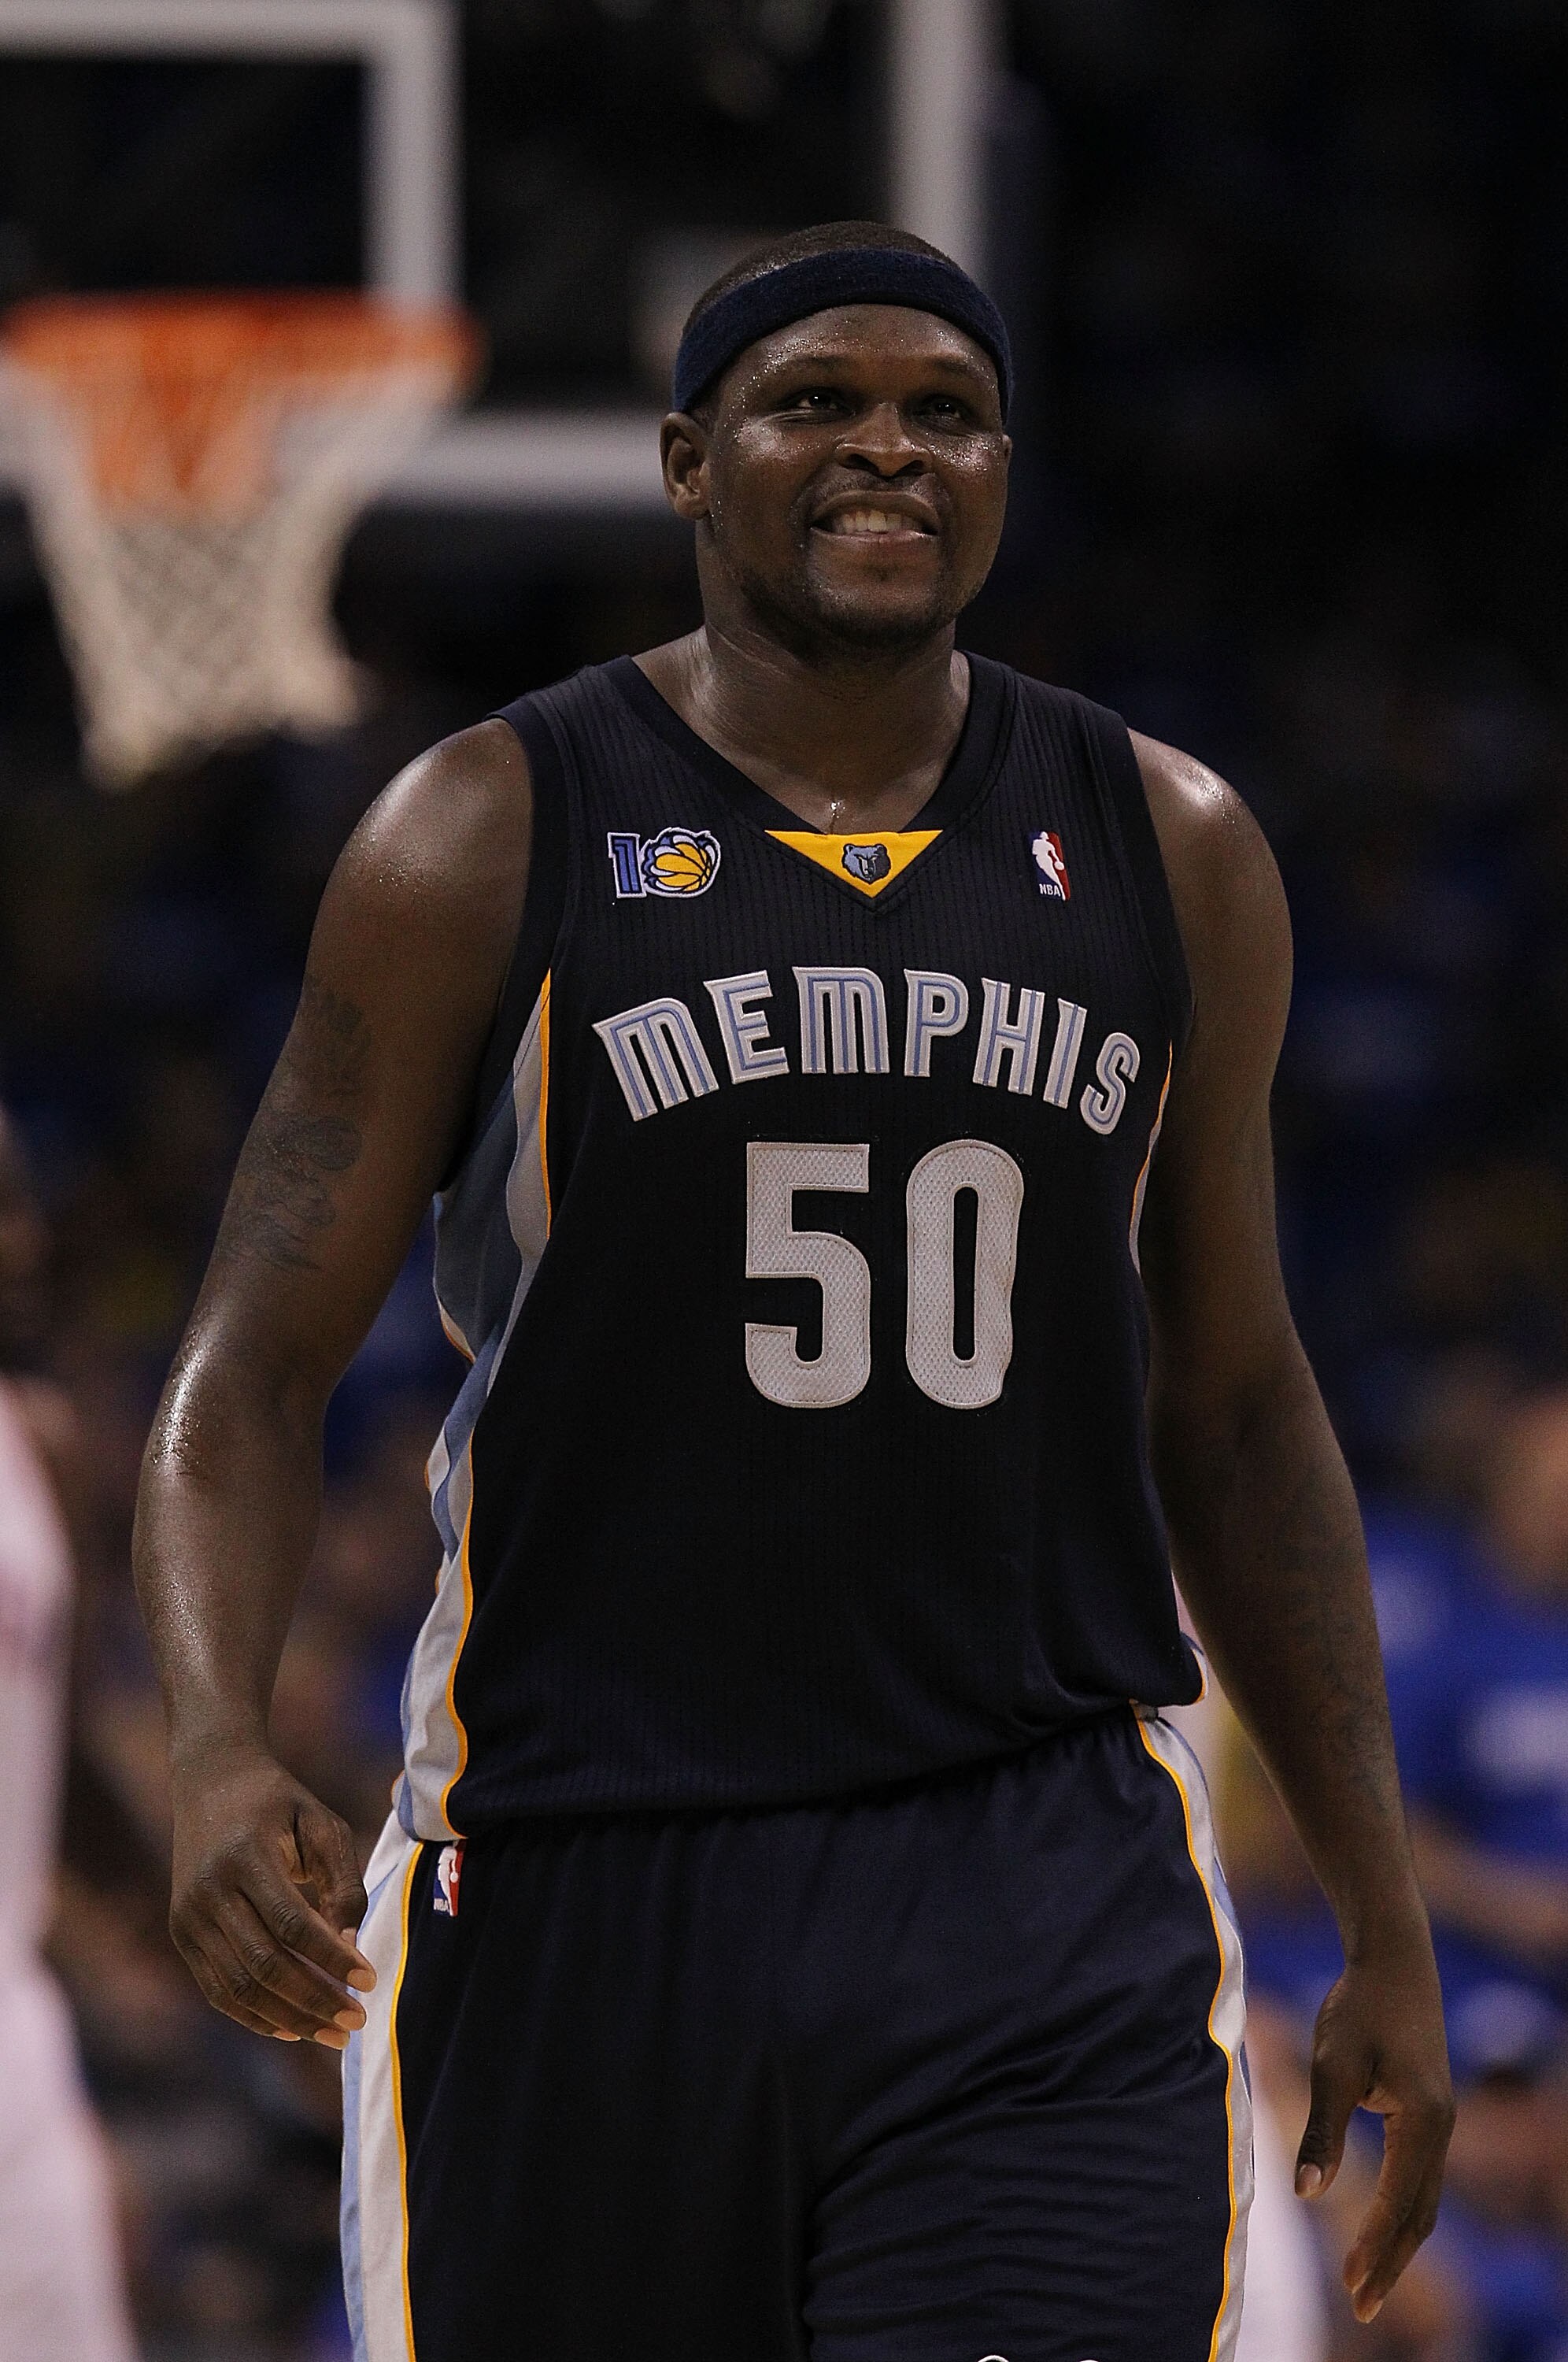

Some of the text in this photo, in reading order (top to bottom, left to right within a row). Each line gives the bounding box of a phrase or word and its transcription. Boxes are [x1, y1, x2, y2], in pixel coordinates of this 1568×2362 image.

[1039, 883, 1061, 897] NBA
[593, 967, 1141, 1135] MEMPHIS
[745, 1139, 1025, 1410] 50
